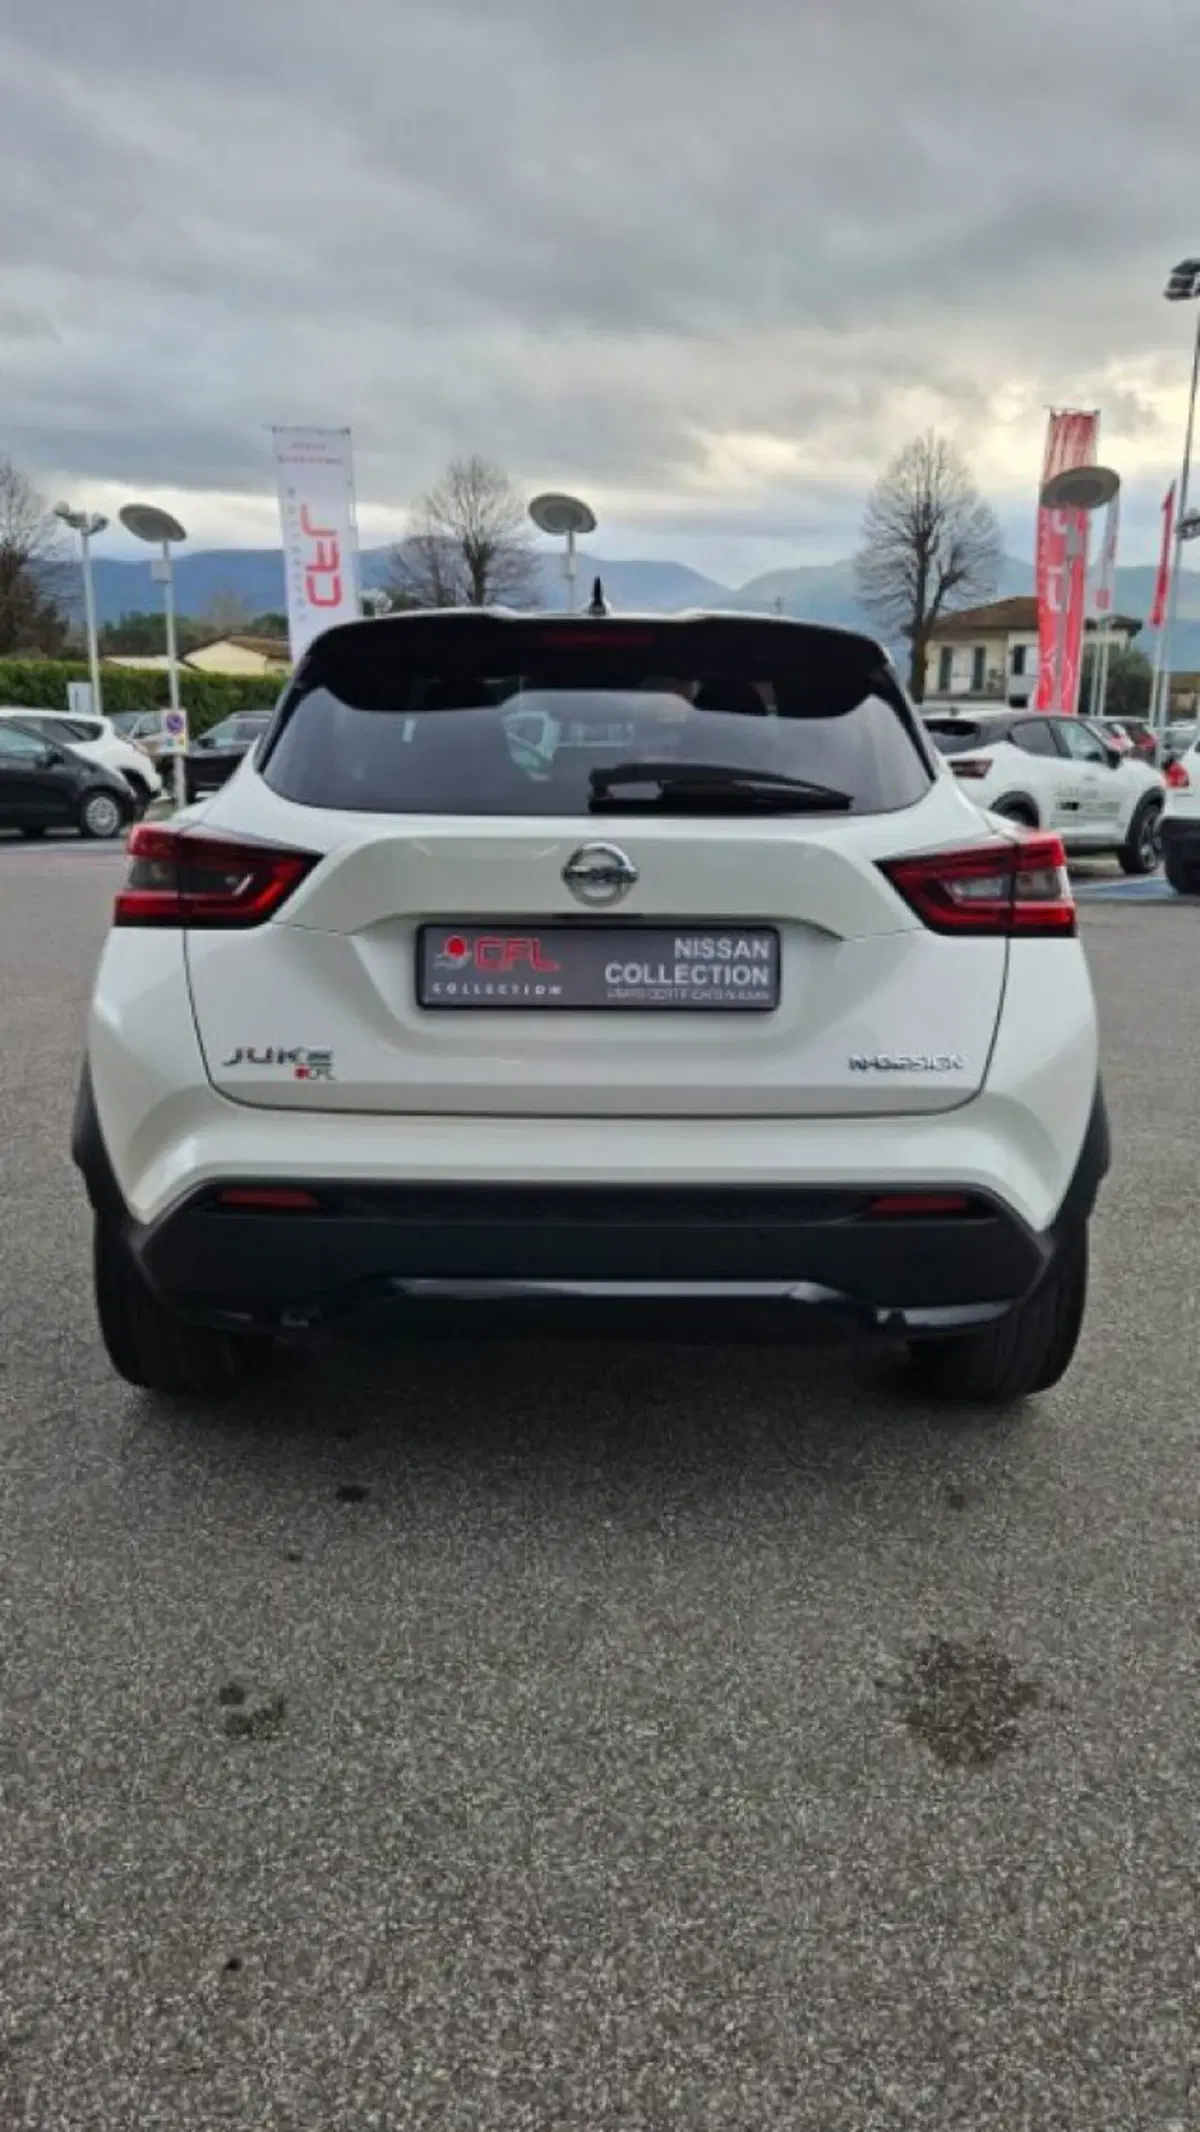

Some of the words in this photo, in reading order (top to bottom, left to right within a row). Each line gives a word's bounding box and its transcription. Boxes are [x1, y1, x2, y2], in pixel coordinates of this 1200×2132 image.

[673, 937, 770, 961] NISSAN
[604, 962, 769, 986] COLLECTION
[432, 981, 562, 996] COLLECTION
[222, 1045, 333, 1067] JUKE
